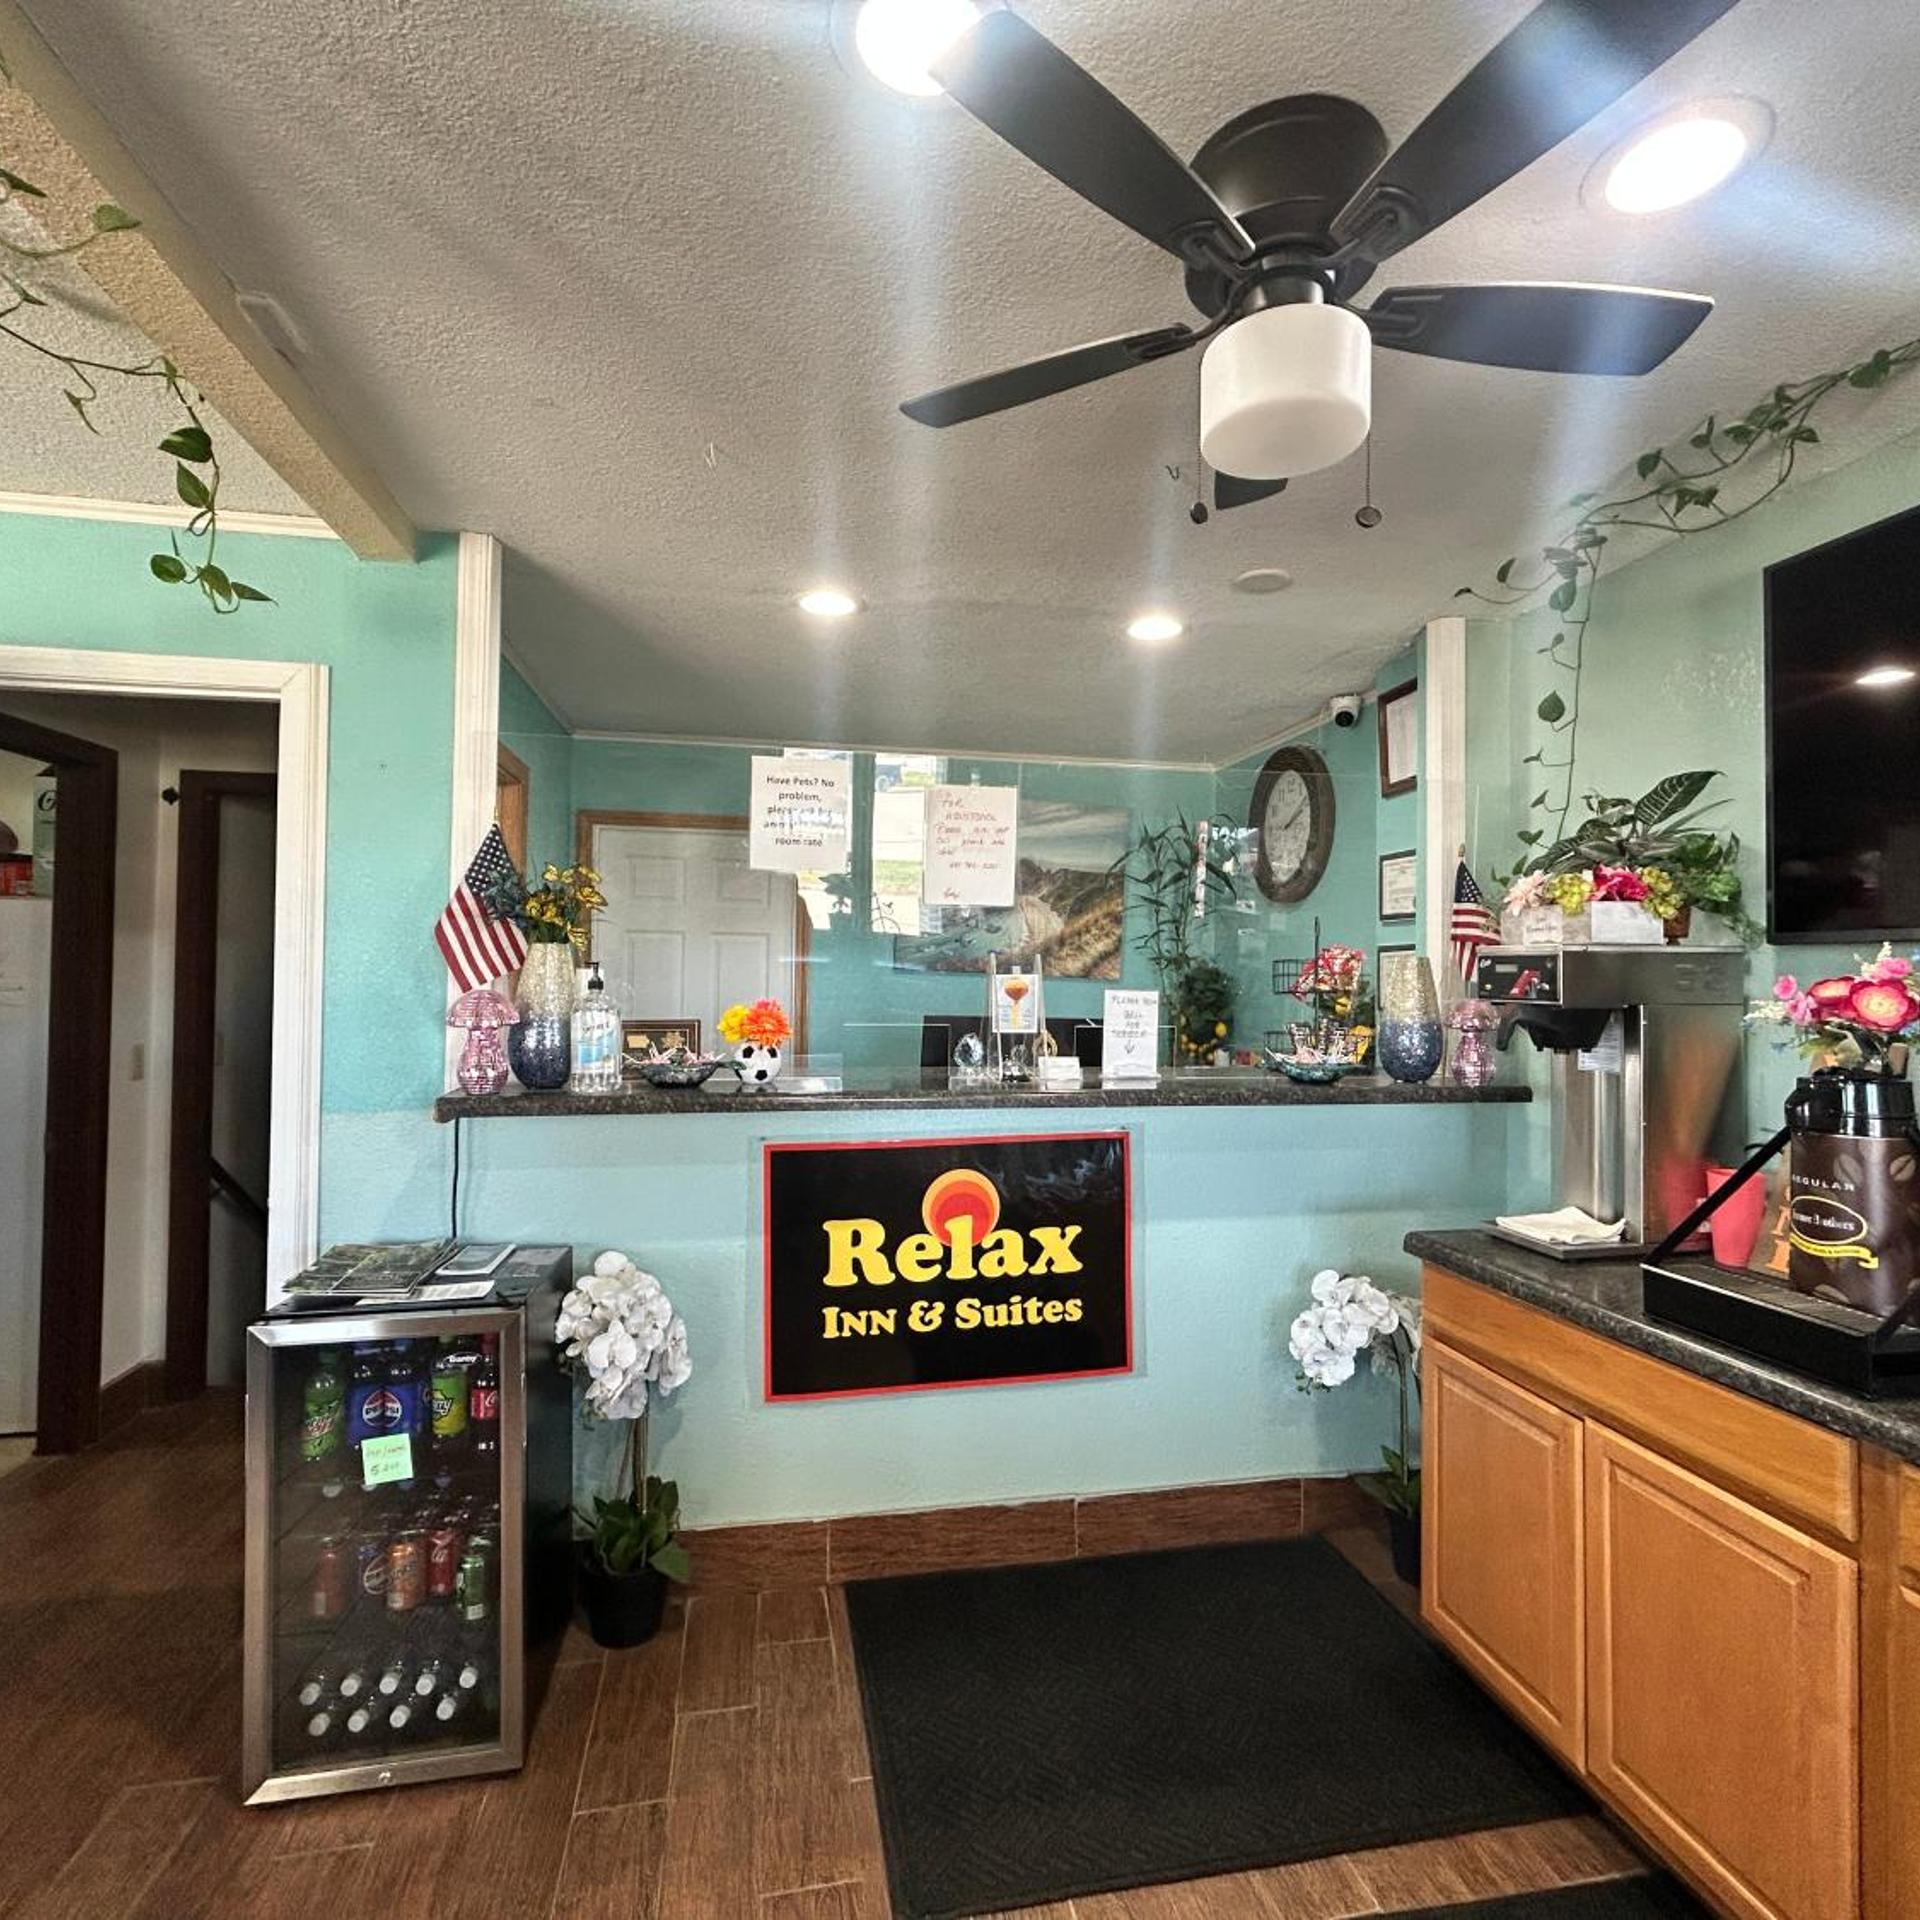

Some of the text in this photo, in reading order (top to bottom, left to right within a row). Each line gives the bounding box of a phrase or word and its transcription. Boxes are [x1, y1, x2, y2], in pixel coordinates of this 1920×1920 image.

[766, 775, 835, 788] Have Pets? No
[778, 791, 822, 803] problem,
[775, 837, 823, 847] room rate
[822, 1214, 1084, 1287] Relax
[907, 1301, 945, 1333] &
[955, 1295, 1084, 1330] Suites
